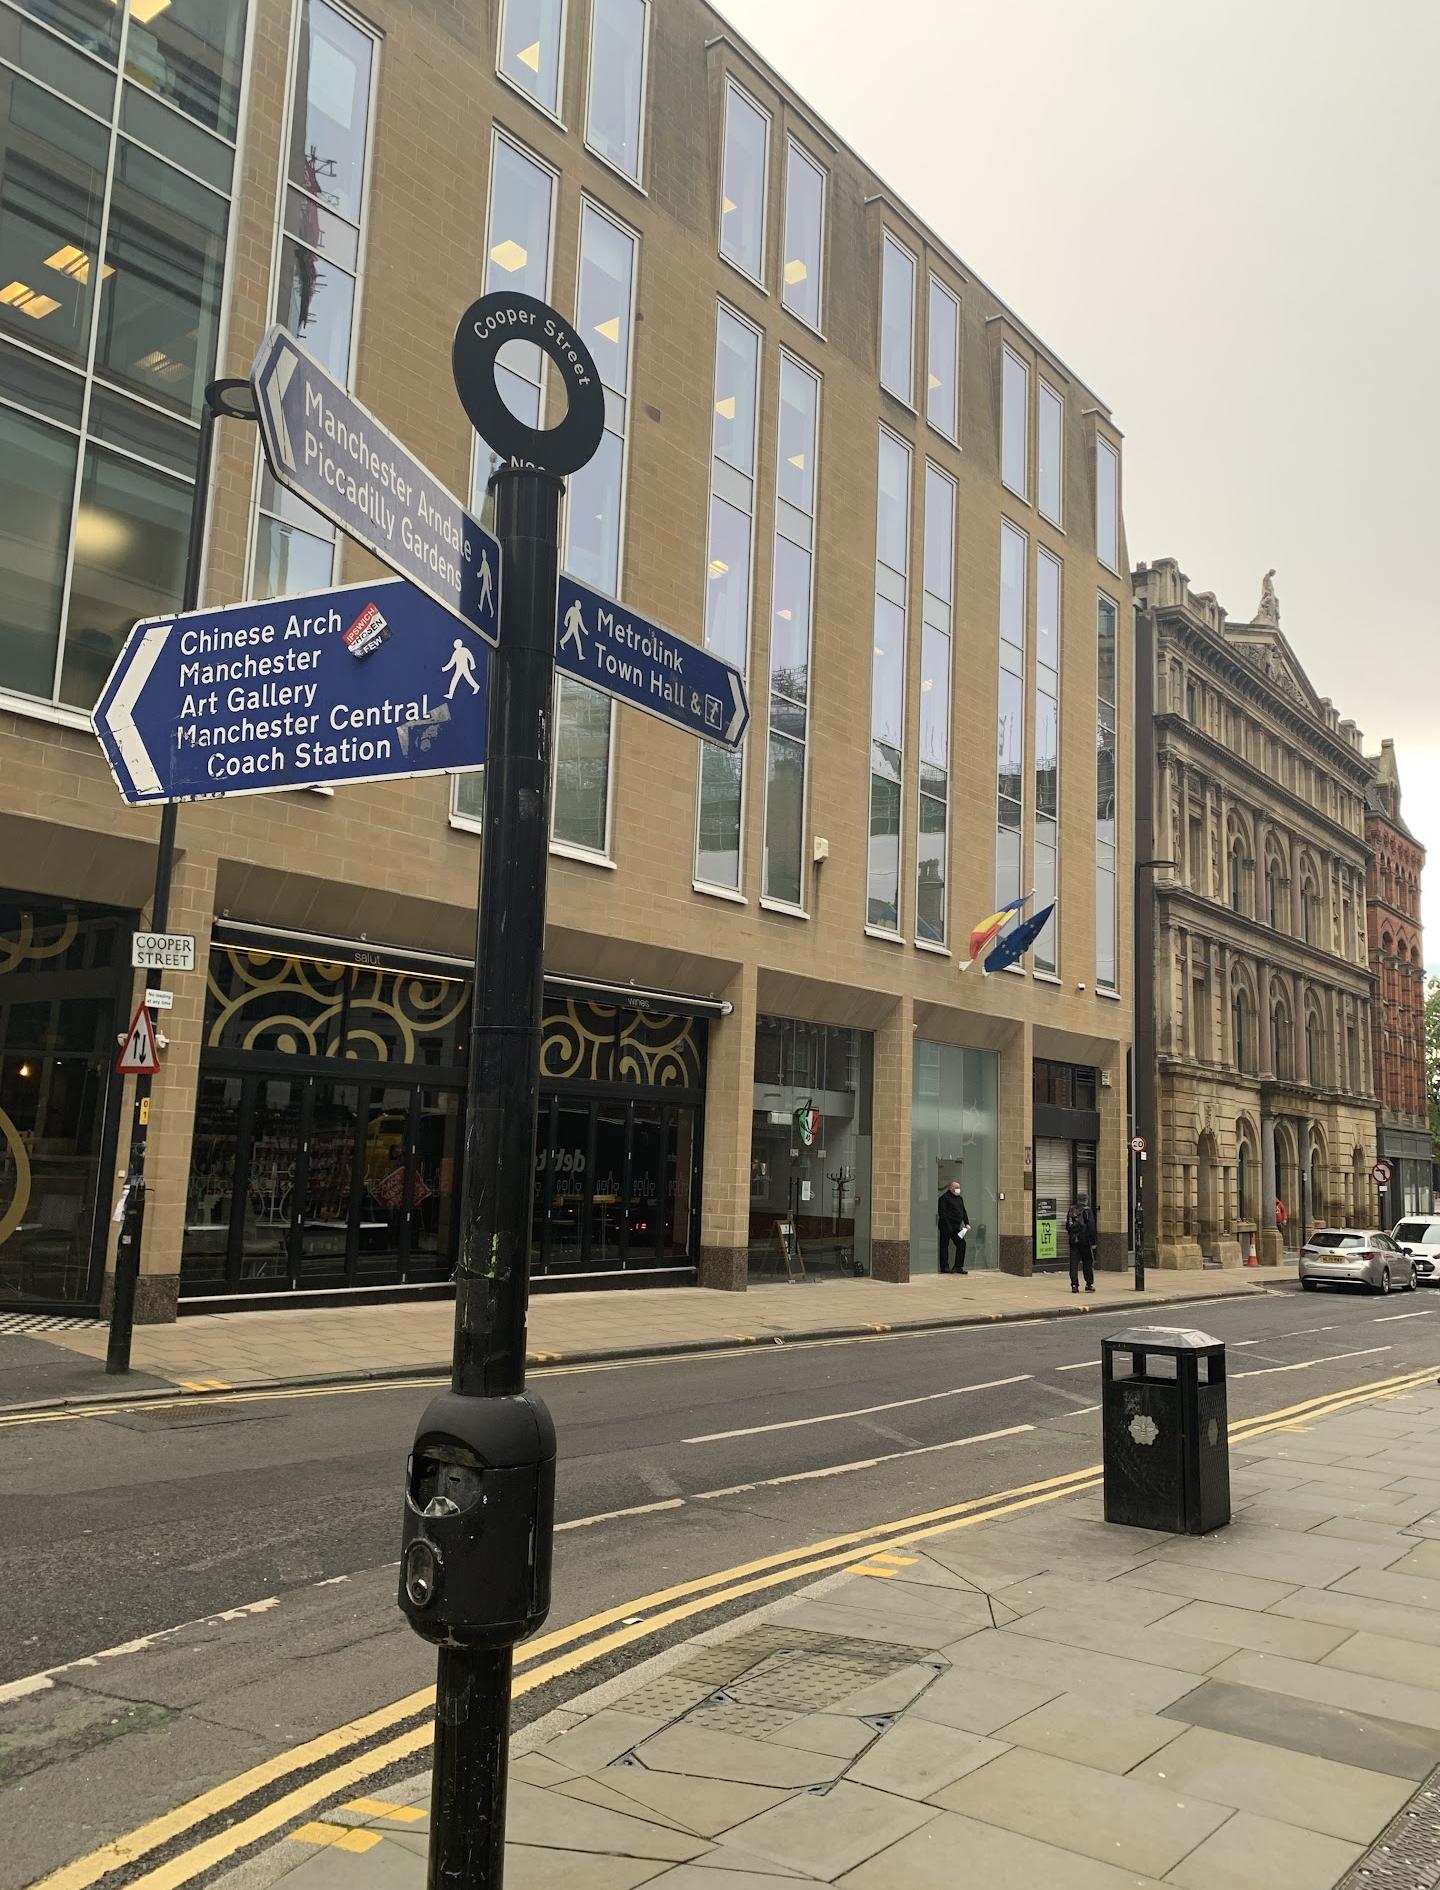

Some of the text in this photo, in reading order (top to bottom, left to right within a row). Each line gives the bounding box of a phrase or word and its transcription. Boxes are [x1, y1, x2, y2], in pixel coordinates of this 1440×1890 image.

[474, 309, 590, 385] Cooper Street
[306, 381, 472, 562] Manchester Arndale
[305, 430, 462, 592] Piccadilly Gardens
[180, 609, 342, 656] Chinese Arch
[347, 608, 374, 642] IPSWICH
[363, 636, 382, 653] FEW
[597, 607, 683, 674] Metrolink
[179, 649, 321, 687] Manchester
[595, 642, 702, 716] Town Hall &
[180, 683, 317, 719] Art Gallery
[177, 694, 431, 750] Manchester Central
[207, 737, 390, 778] Coach Station
[137, 936, 191, 951] COOPER
[137, 952, 189, 966] STREET
[1042, 1222, 1051, 1233] TO
[1042, 1234, 1052, 1244] LET
